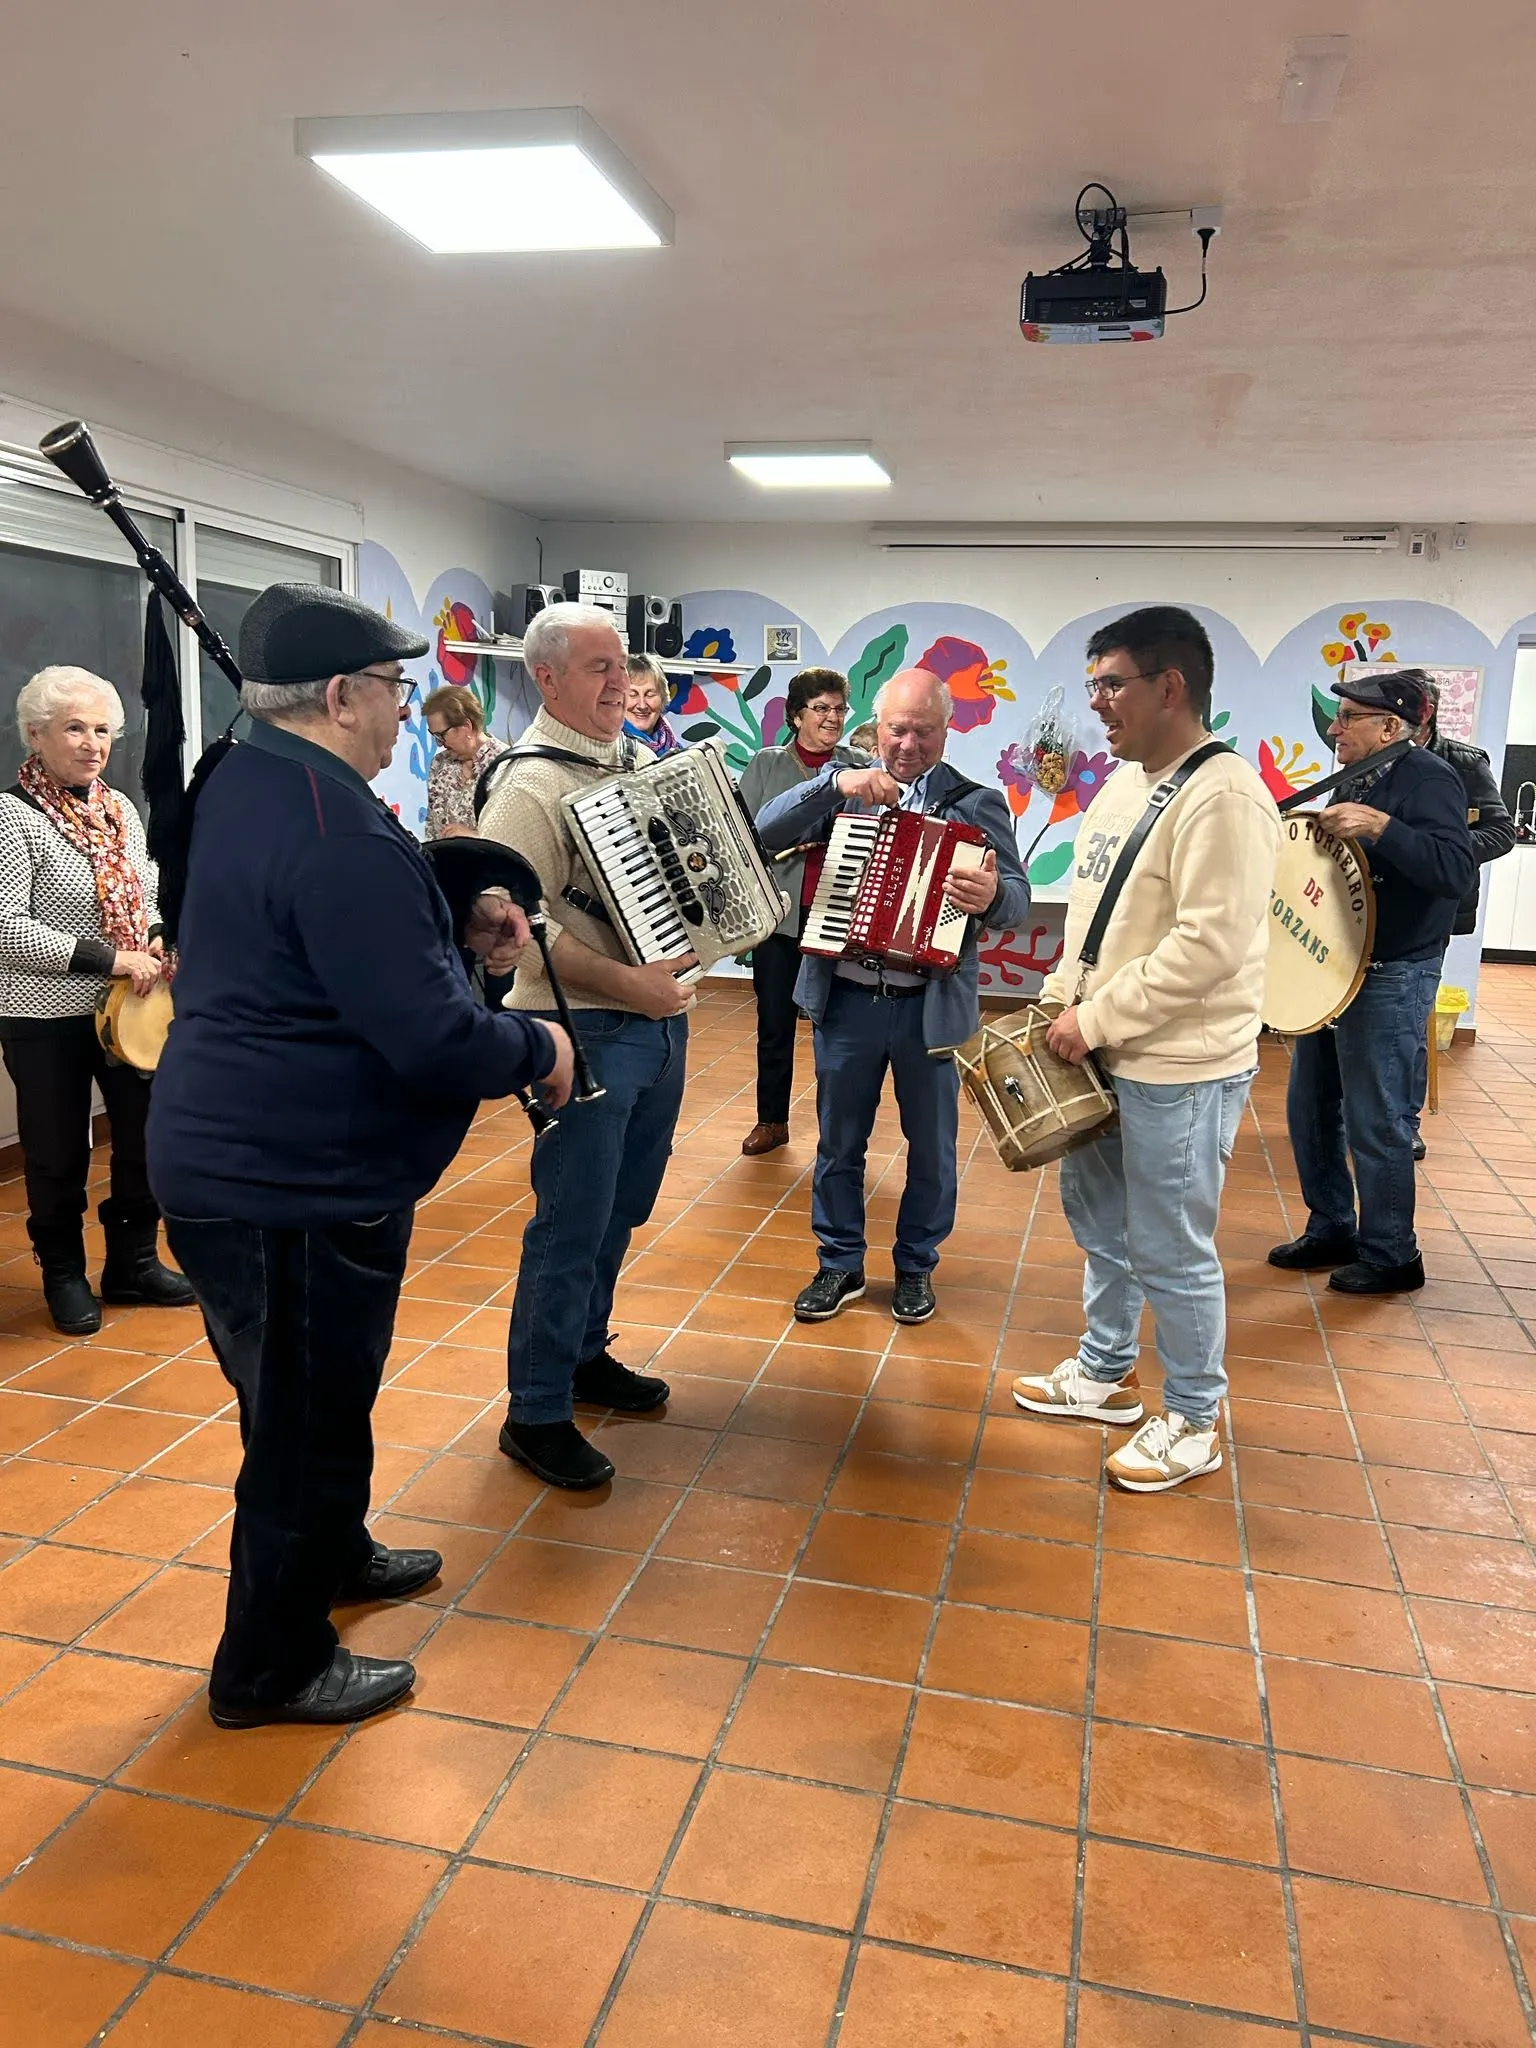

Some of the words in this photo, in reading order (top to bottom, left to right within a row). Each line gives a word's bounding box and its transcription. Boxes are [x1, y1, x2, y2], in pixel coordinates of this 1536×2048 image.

[884, 857, 905, 907] BALZER
[1077, 832, 1120, 883] 36
[1289, 822, 1298, 840] O
[1304, 821, 1364, 912] TORREIRO
[1303, 877, 1324, 907] DE
